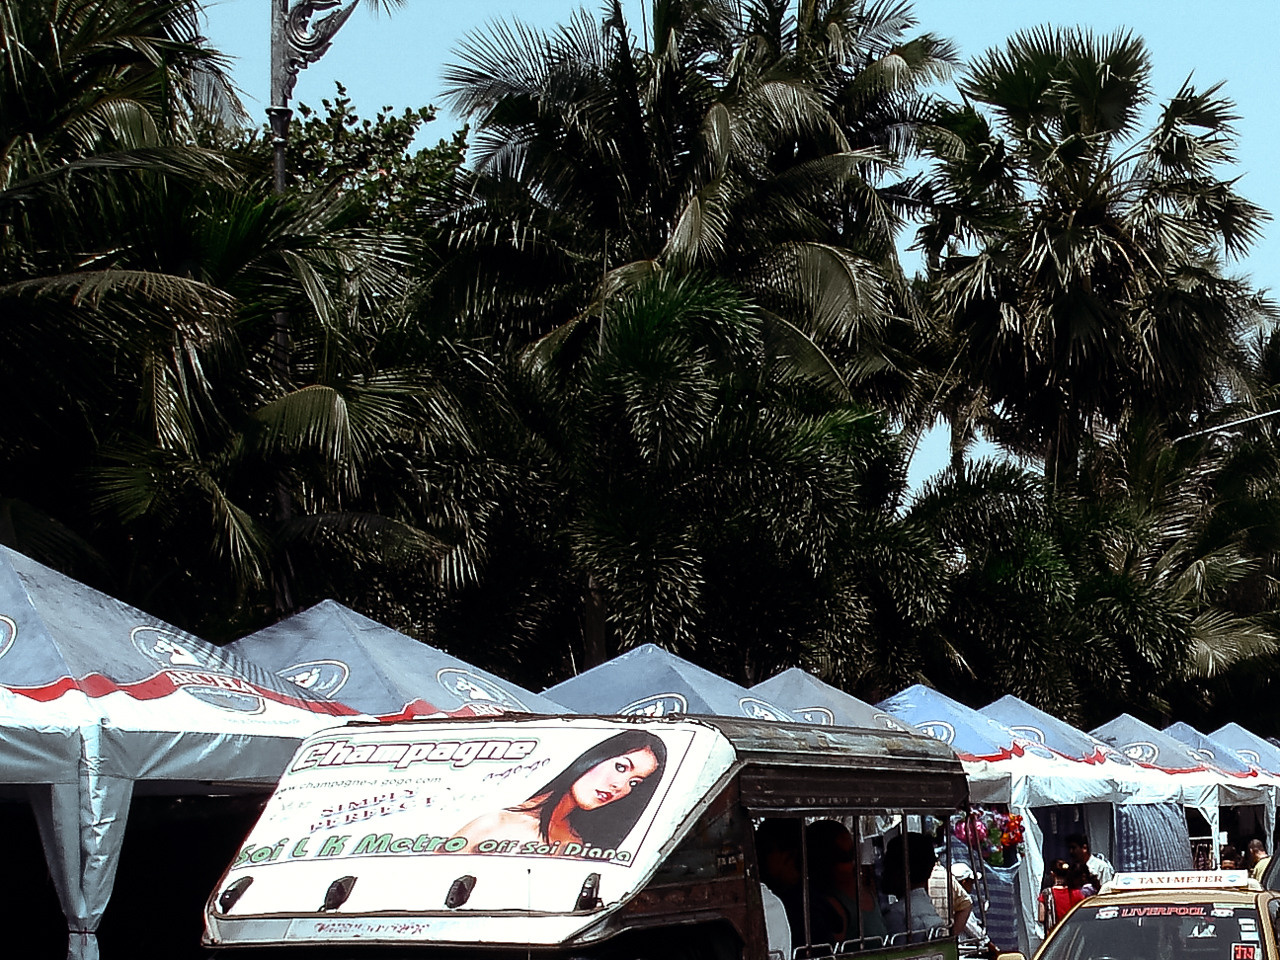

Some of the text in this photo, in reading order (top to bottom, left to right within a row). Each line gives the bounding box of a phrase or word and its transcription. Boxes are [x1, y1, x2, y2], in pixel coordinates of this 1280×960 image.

[289, 740, 538, 773] Champagne
[234, 832, 632, 865] Soi L K Metro Off Soi Diana
[1121, 906, 1207, 917] LIVERPOOL
